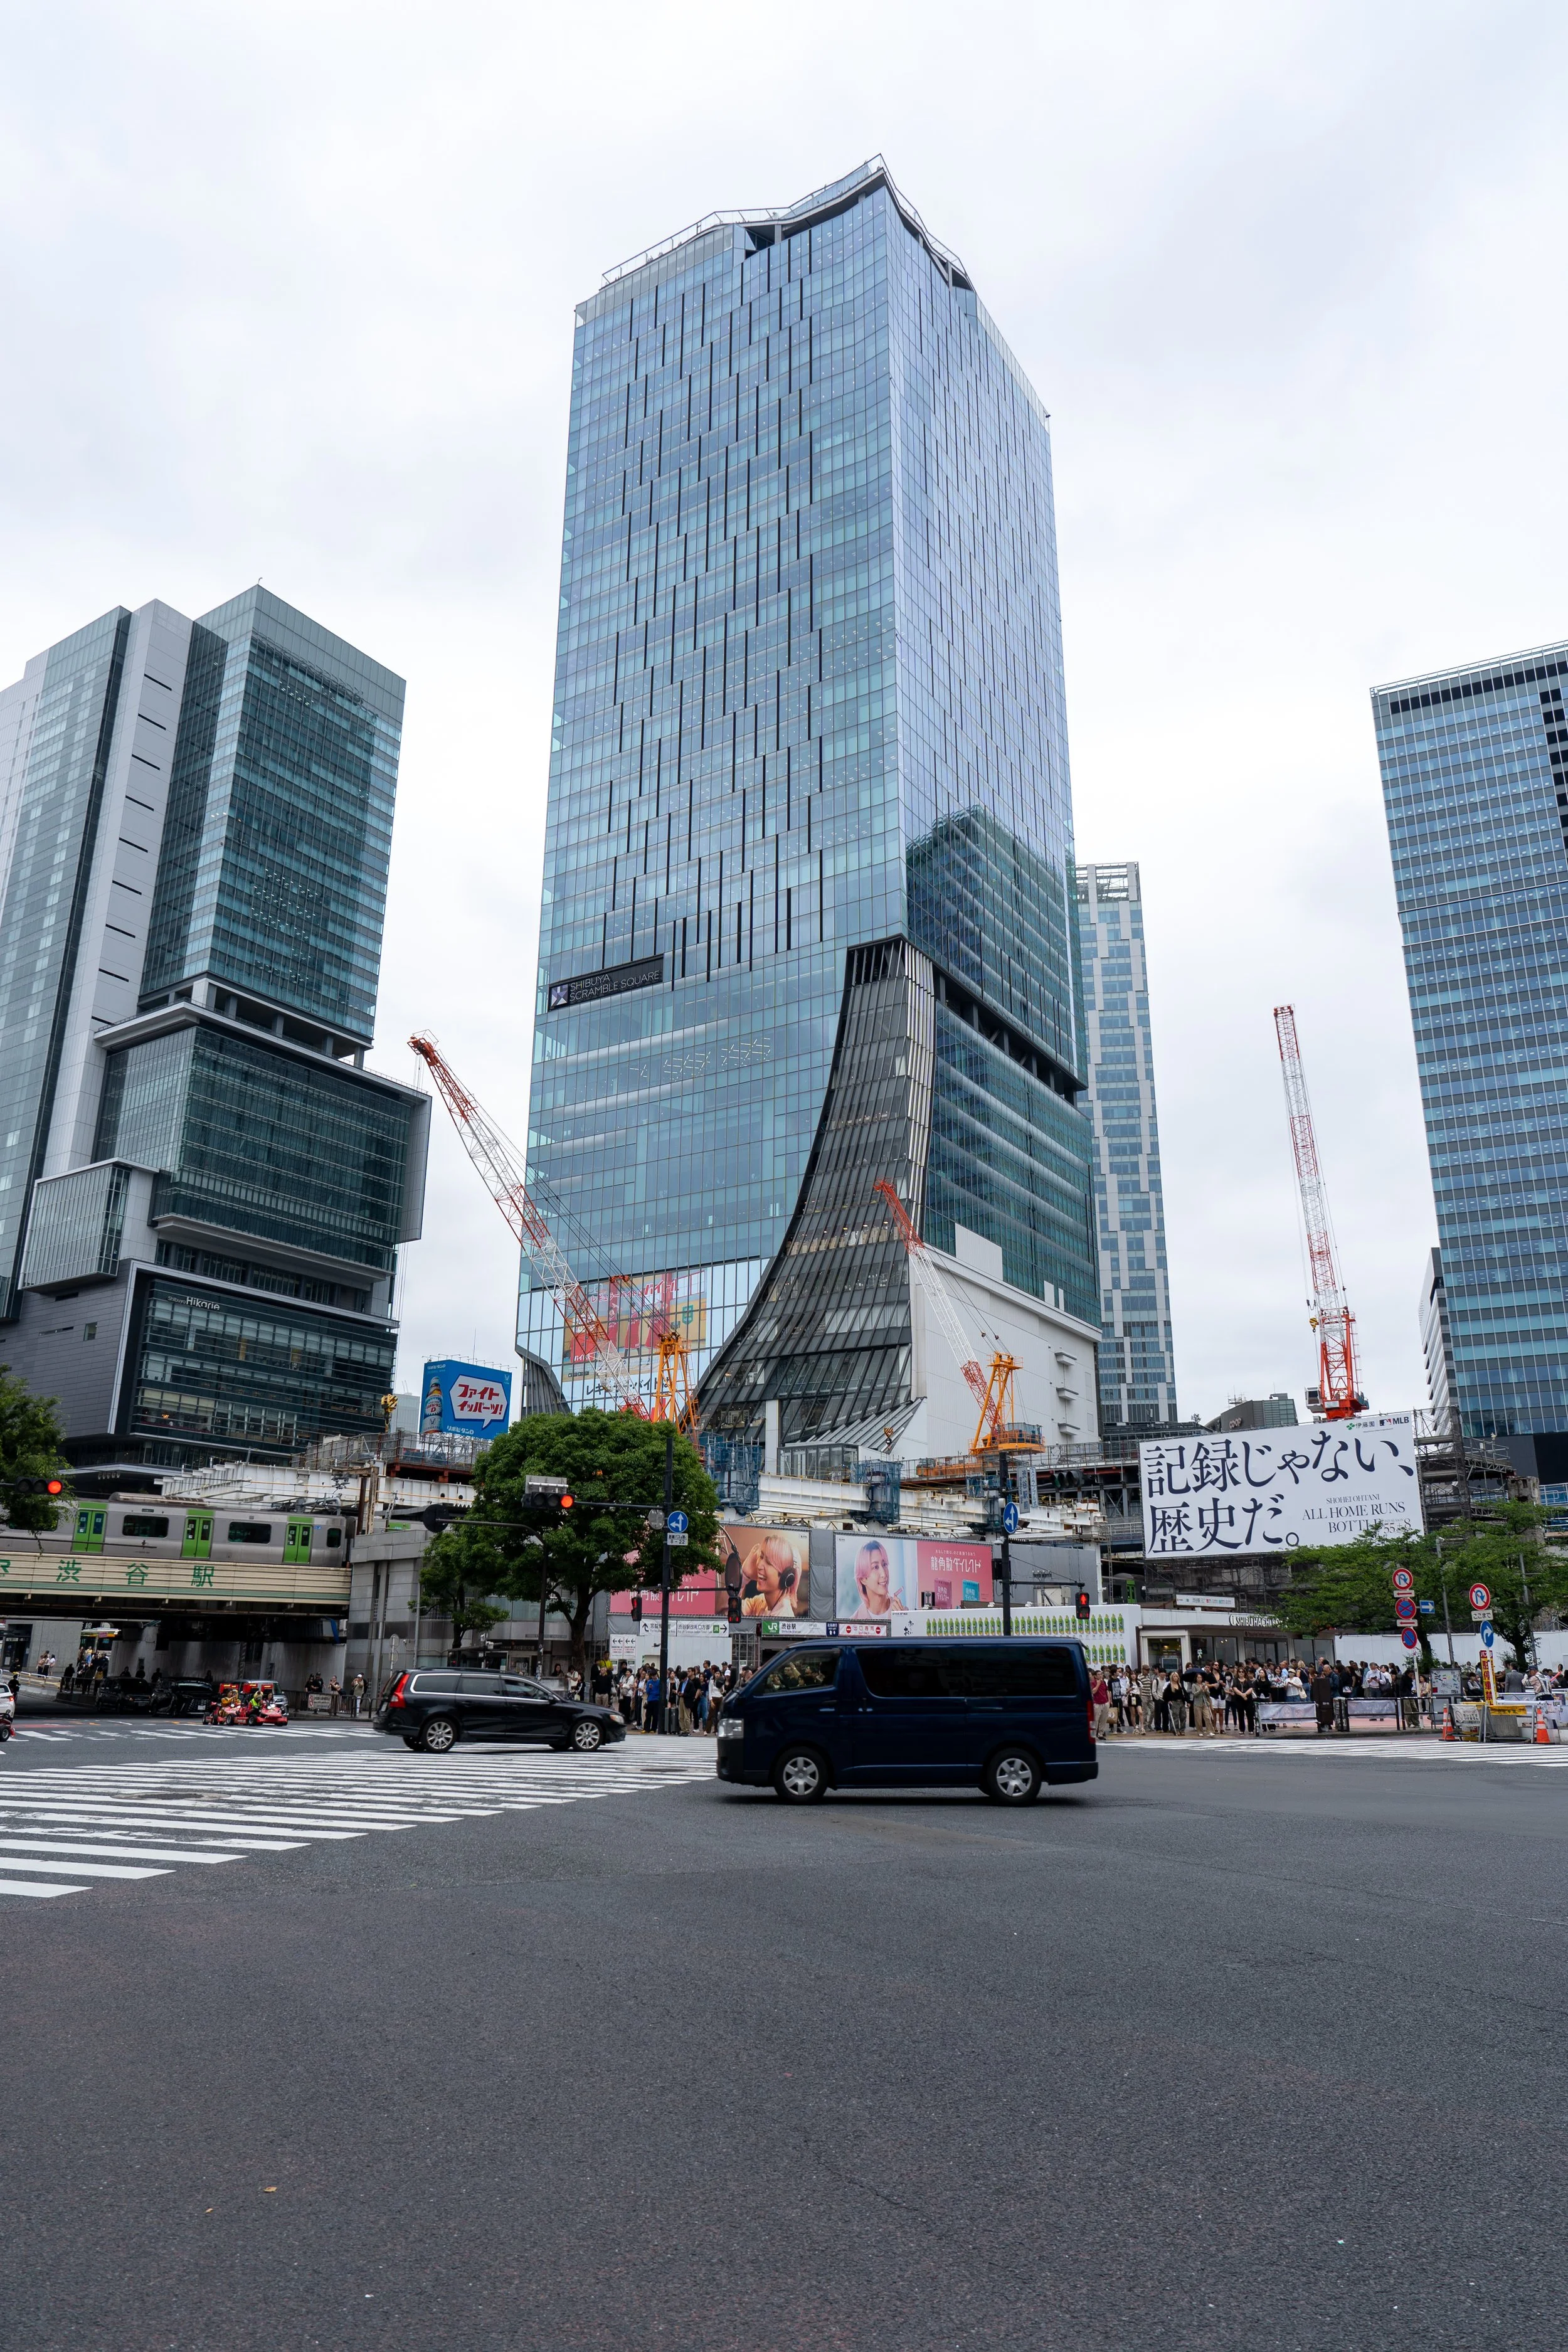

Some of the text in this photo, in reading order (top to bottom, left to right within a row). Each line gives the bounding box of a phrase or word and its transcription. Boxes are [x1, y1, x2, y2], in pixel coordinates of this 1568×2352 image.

[569, 970, 659, 1002] SCRAMBLE SQUARE
[570, 974, 610, 992] SHIBUYA
[167, 1296, 220, 1310] Shibuya Hikarie
[457, 1384, 499, 1401] ファイト
[457, 1401, 504, 1415] イッパーツ!
[1355, 1421, 1375, 1429] 伊藤園
[1392, 1416, 1409, 1425] MLB
[447, 1425, 474, 1435] リポビタンD
[1144, 1430, 1414, 1498] 記録じゃない、
[1326, 1493, 1380, 1504] SHOHEI OHTANI
[1302, 1502, 1406, 1520] ALL HOME RUNS
[1148, 1493, 1300, 1553] 歴史だ。
[931, 1555, 981, 1573] 龍角散ダイレクト
[56, 1559, 215, 1587] 渋谷駅
[1236, 1616, 1253, 1626] SHIBU
[1473, 1612, 1491, 1620] ここまで
